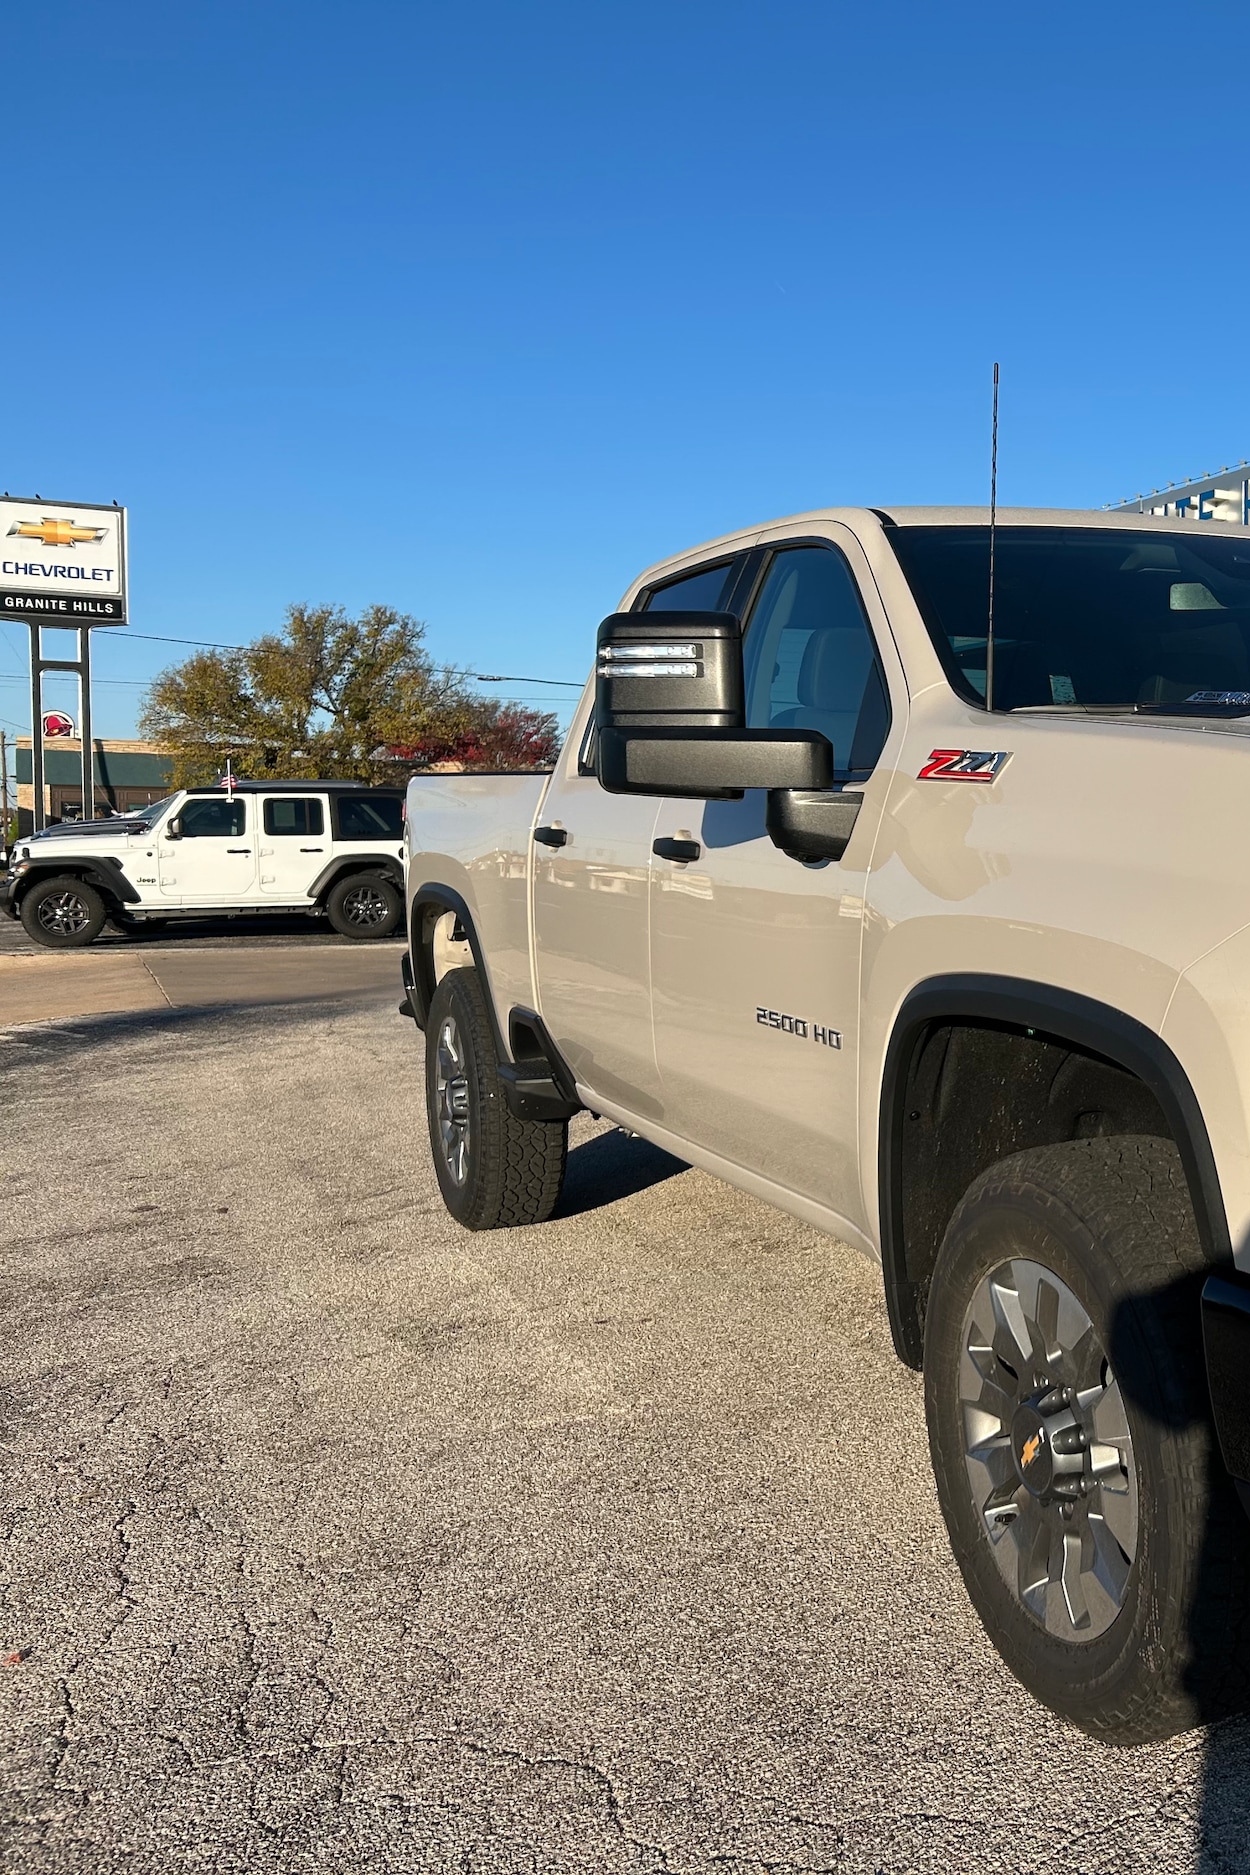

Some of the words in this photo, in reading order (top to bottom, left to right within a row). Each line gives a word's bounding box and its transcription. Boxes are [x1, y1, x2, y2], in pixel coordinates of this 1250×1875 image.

[2, 561, 114, 581] CHEVROLET
[4, 597, 67, 611] GRANITE
[73, 601, 114, 614] HILLS
[917, 749, 1010, 782] Z71
[756, 1006, 809, 1038] 2500
[813, 1023, 843, 1050] HD
